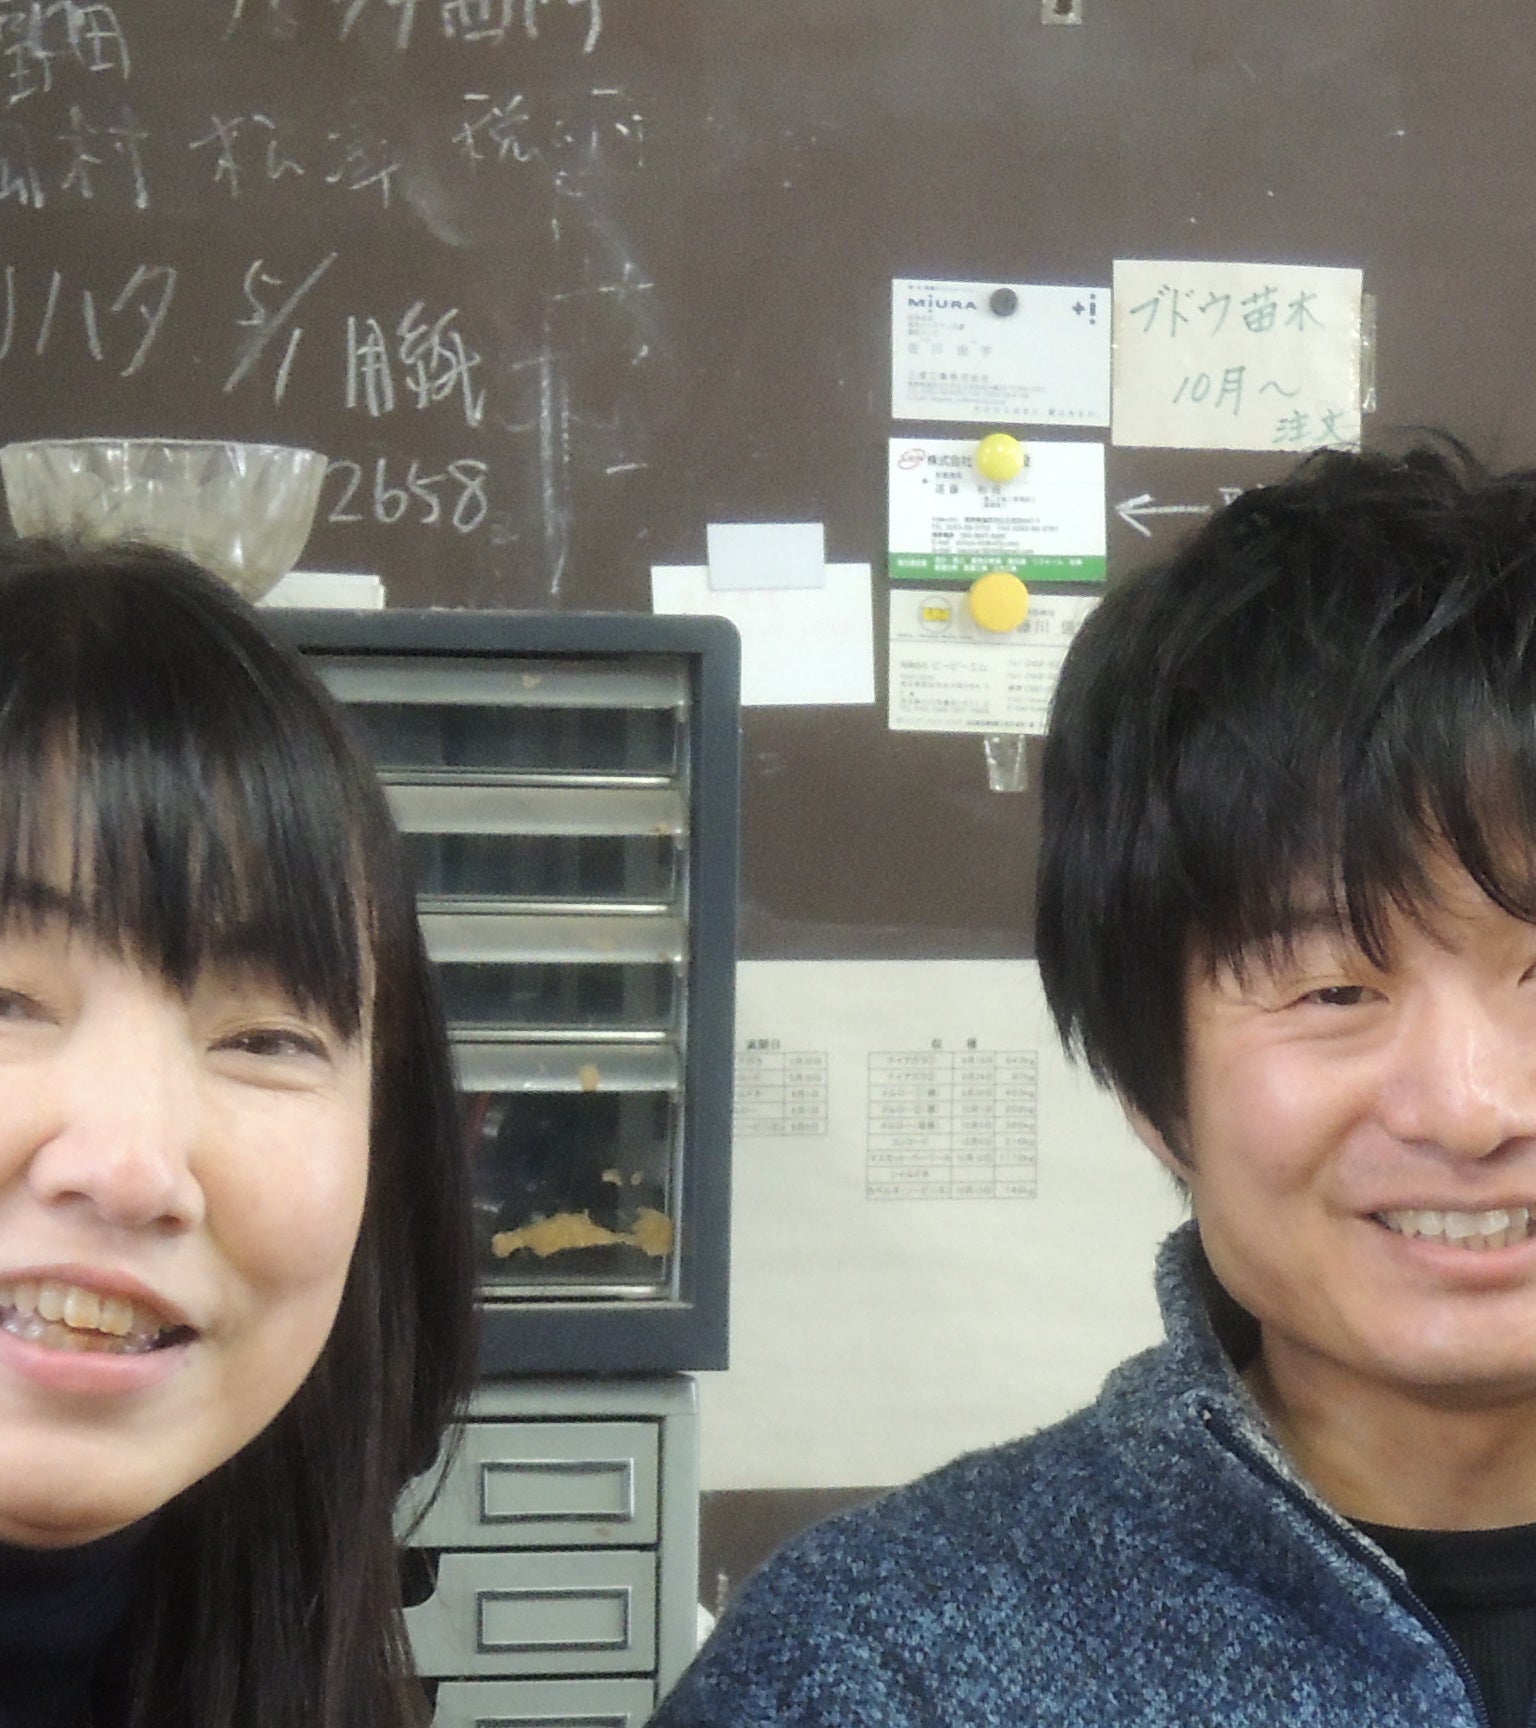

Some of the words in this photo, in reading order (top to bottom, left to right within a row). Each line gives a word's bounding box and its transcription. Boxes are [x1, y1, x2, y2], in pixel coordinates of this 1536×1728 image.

[1129, 284, 1326, 338] ブドウ苗木
[326, 457, 491, 534] 2658
